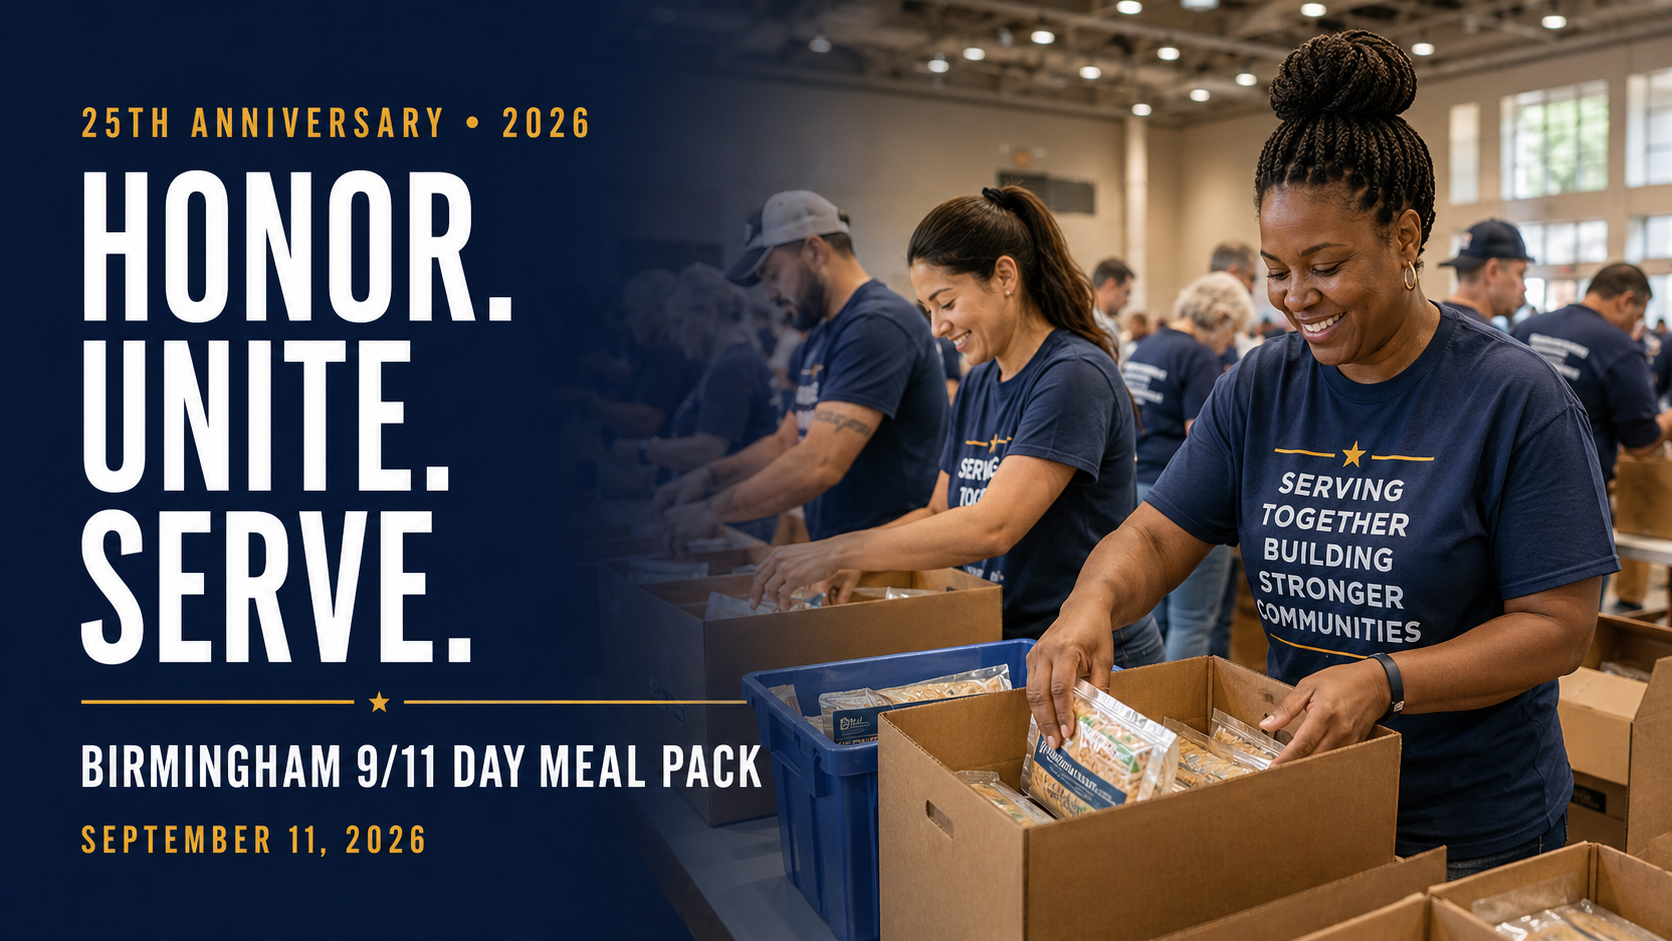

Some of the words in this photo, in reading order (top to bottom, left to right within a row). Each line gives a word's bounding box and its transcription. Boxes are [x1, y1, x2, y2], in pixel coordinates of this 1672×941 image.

[1278, 471, 1405, 503] SERVING
[1261, 503, 1410, 537] TOGETHER
[1263, 537, 1394, 572] BUILDING
[1258, 570, 1405, 610] STRONGER
[1256, 598, 1422, 644] COMMUNITIES
